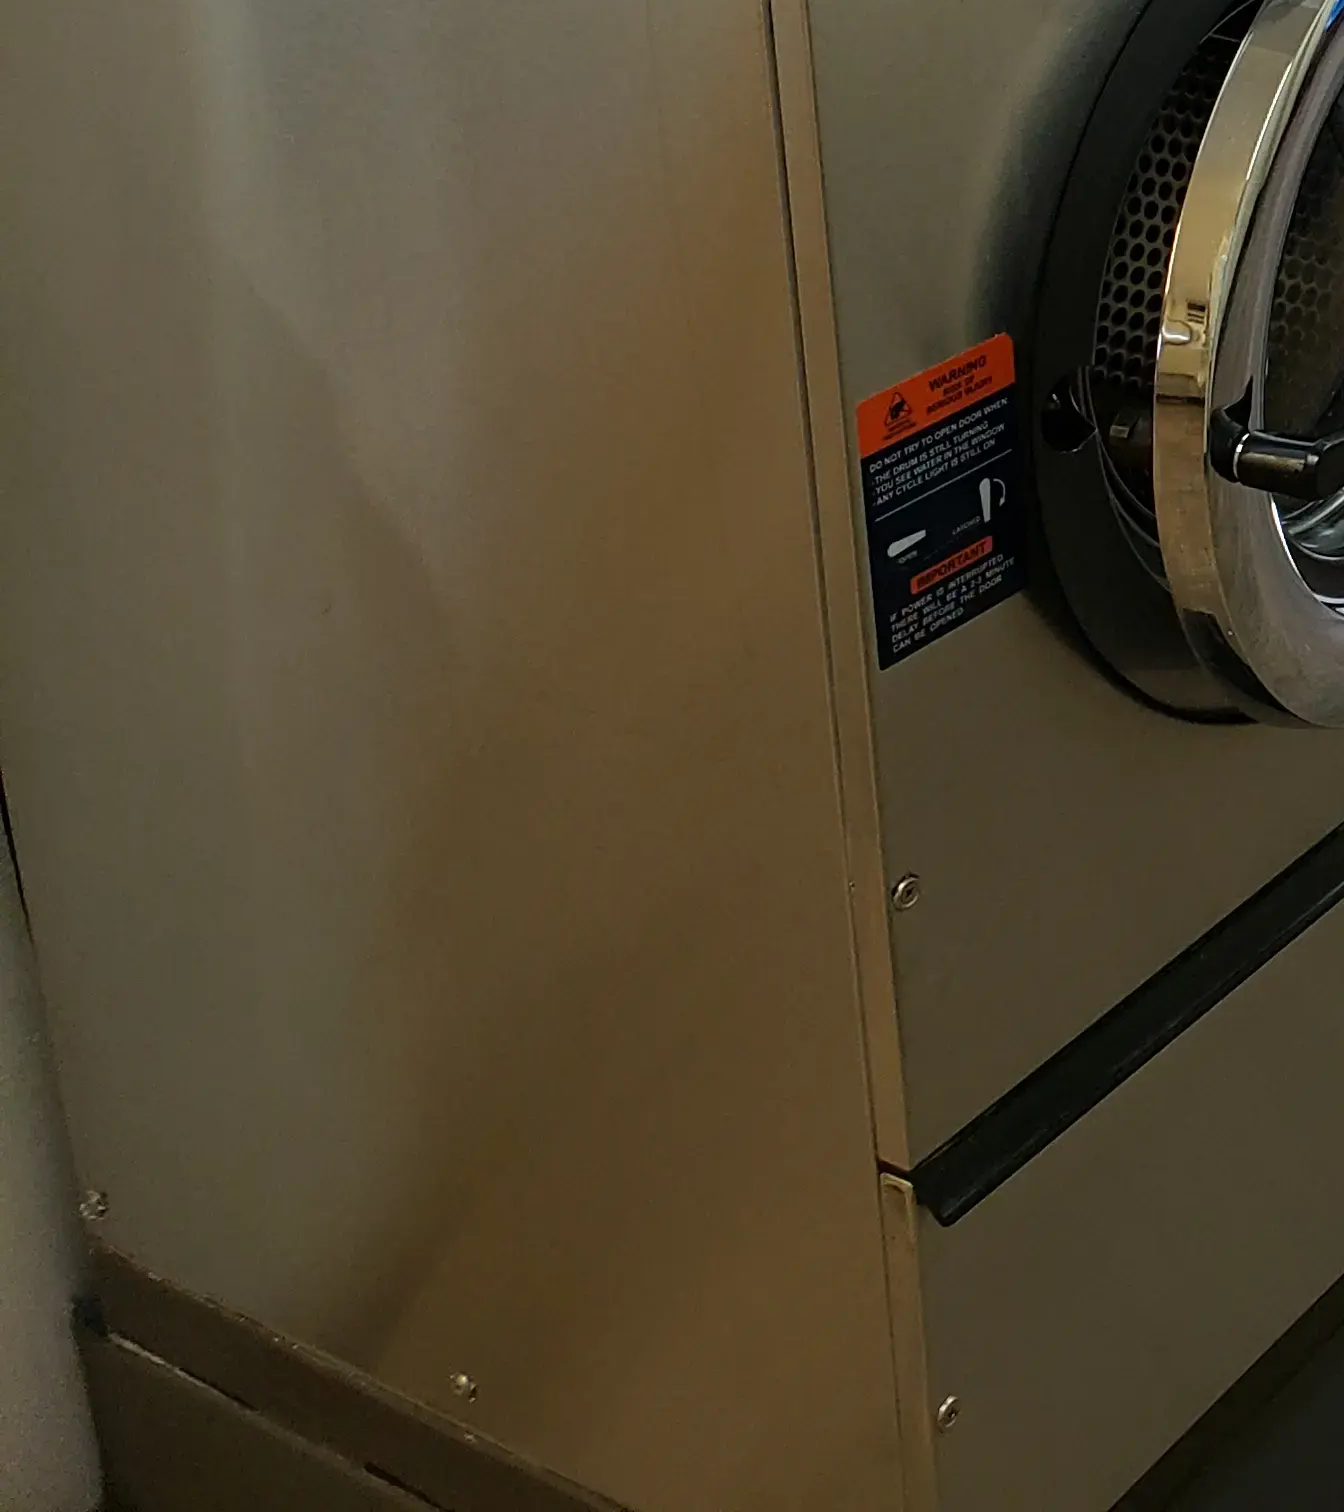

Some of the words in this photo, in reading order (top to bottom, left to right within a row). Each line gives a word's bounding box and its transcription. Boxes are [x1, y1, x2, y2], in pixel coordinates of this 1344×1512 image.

[928, 354, 986, 393] WARNING
[869, 459, 881, 474] DO
[884, 449, 901, 466] NOT
[903, 440, 919, 455] TRY
[921, 434, 932, 446] TO
[934, 421, 956, 440] OPEN
[958, 409, 981, 428] DOOR
[893, 455, 918, 475] DRUM
[919, 451, 927, 461] IS
[929, 438, 951, 456] STILL
[953, 419, 988, 444] TURNING
[895, 474, 923, 495] CYCLE
[924, 461, 948, 480] LIGHT
[950, 457, 957, 467] IS
[959, 444, 981, 462] STILL
[983, 437, 994, 450] ON
[896, 470, 911, 484] SEE
[913, 454, 942, 475] WATER
[943, 449, 951, 460] IN
[954, 440, 969, 454] THE
[971, 422, 1004, 446] WINDOW
[890, 611, 918, 633] THERE
[922, 598, 941, 614] WILL
[946, 589, 956, 601] BE
[960, 583, 967, 593] A
[985, 556, 1014, 579] MINUTE
[901, 592, 933, 616] POWER
[936, 585, 944, 597] IS
[948, 553, 1002, 590] INTERRUPTED
[916, 540, 987, 589] IMPORTANT
[891, 622, 918, 643] DELAY
[922, 600, 954, 625] BEFORE
[959, 589, 975, 604] THE
[979, 574, 1001, 593] DOOR
[892, 636, 911, 654] CAN
[914, 627, 926, 640] BE
[929, 606, 963, 632] OPENED
